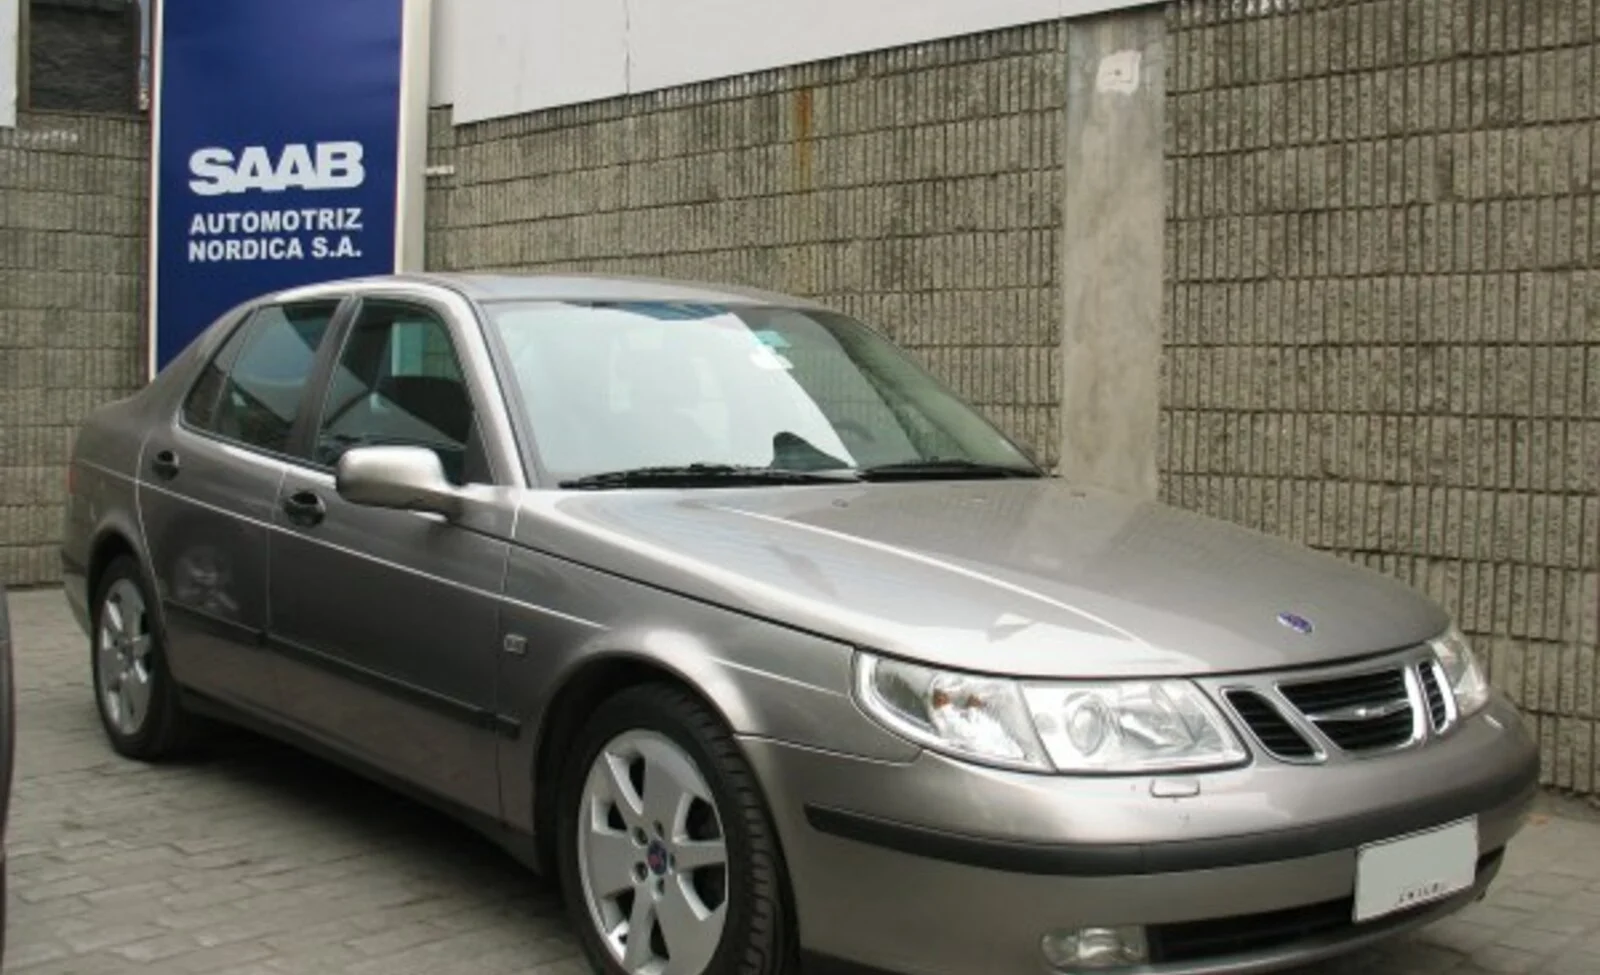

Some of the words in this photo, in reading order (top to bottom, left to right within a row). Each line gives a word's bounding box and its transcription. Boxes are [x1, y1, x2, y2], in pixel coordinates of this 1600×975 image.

[189, 141, 365, 195] SAAB
[190, 208, 363, 235] AUTOMOTRIZ
[188, 238, 303, 262] NORDICA
[311, 236, 362, 257] S.A.
